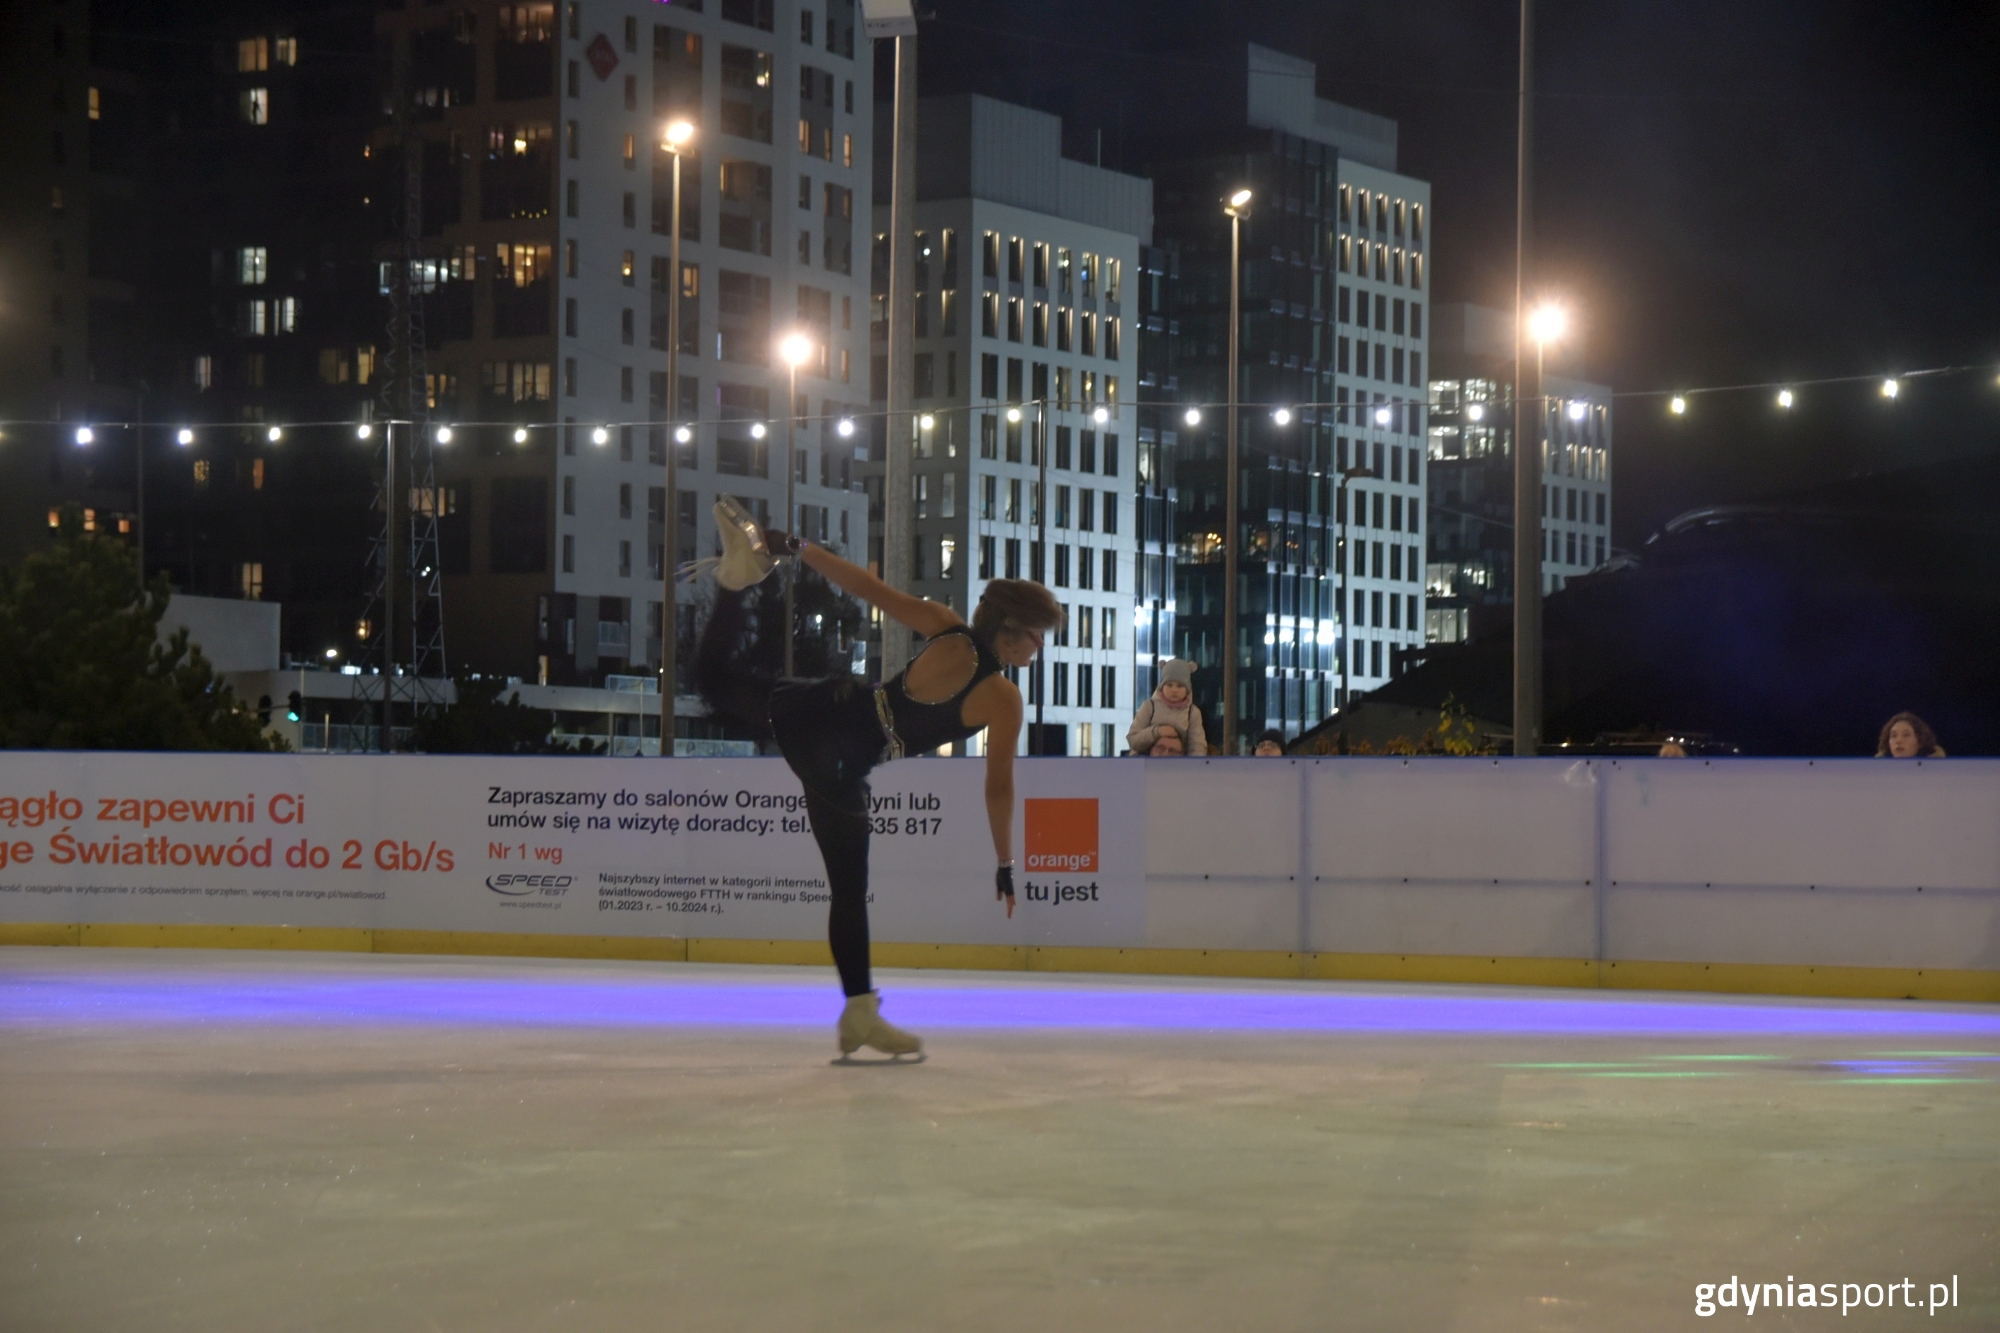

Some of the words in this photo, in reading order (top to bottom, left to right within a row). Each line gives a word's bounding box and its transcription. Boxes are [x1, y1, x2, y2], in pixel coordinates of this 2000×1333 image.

[97, 792, 254, 828] zapewni
[268, 793, 304, 824] Ci
[488, 787, 607, 809] Zapraszamy
[613, 788, 638, 806] do
[645, 789, 728, 808] salonów
[735, 790, 808, 813] Orange
[909, 792, 941, 810] lub
[488, 810, 546, 827] umów
[552, 812, 580, 833] się
[587, 815, 611, 829] na
[618, 812, 680, 835] wizytę
[687, 813, 774, 836] doradcy:
[781, 816, 811, 833] tel.
[905, 817, 942, 835] 817
[49, 826, 272, 868] Światłowód
[285, 838, 330, 868] do
[342, 839, 362, 869] 2
[375, 839, 455, 872] Gb/s
[488, 842, 511, 859] Nr
[518, 843, 526, 860] 1
[534, 847, 562, 865] wg
[1028, 855, 1091, 870] orange
[495, 874, 573, 887] SPEED
[599, 872, 660, 886] Najszybszy
[664, 874, 706, 885] internet
[709, 877, 719, 885] w
[722, 875, 771, 888] kategorii
[775, 877, 825, 889] internetu
[539, 888, 568, 896] TEST
[599, 886, 696, 900] światłowodowego
[700, 889, 730, 899] FTTH
[734, 891, 744, 899] w
[747, 891, 796, 904] rankingu
[1025, 881, 1049, 901] tu
[1053, 880, 1099, 905] jest
[599, 900, 643, 912] (01.2023
[666, 902, 707, 913] 10.2024
